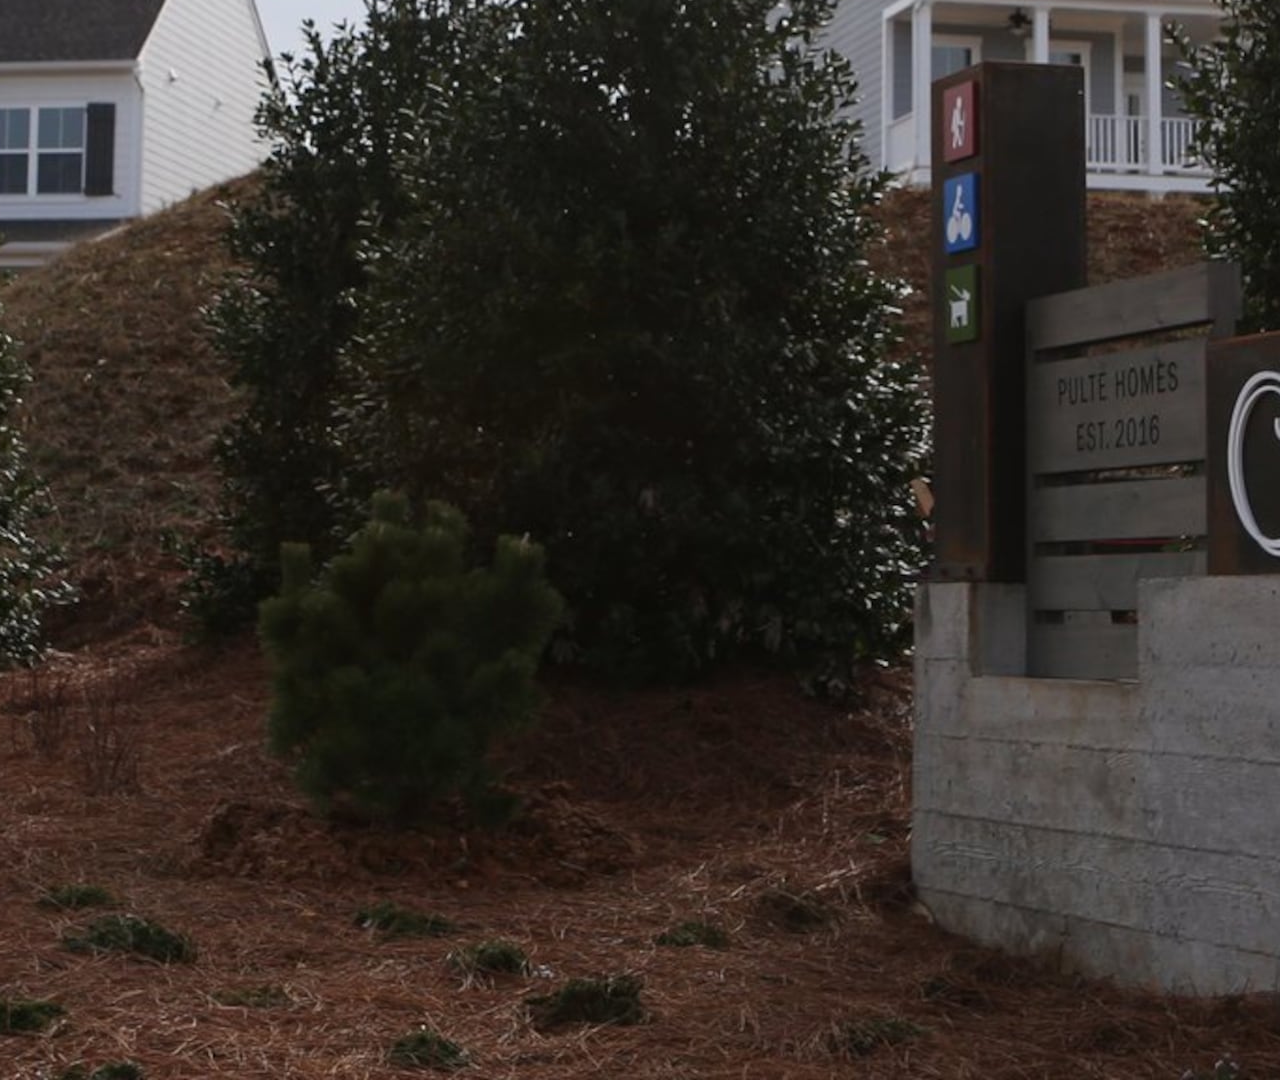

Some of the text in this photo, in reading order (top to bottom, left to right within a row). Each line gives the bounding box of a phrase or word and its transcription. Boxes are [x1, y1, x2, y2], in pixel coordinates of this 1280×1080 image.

[1057, 361, 1179, 406] PULTE HOMES
[1076, 414, 1160, 452] EST. 2016
